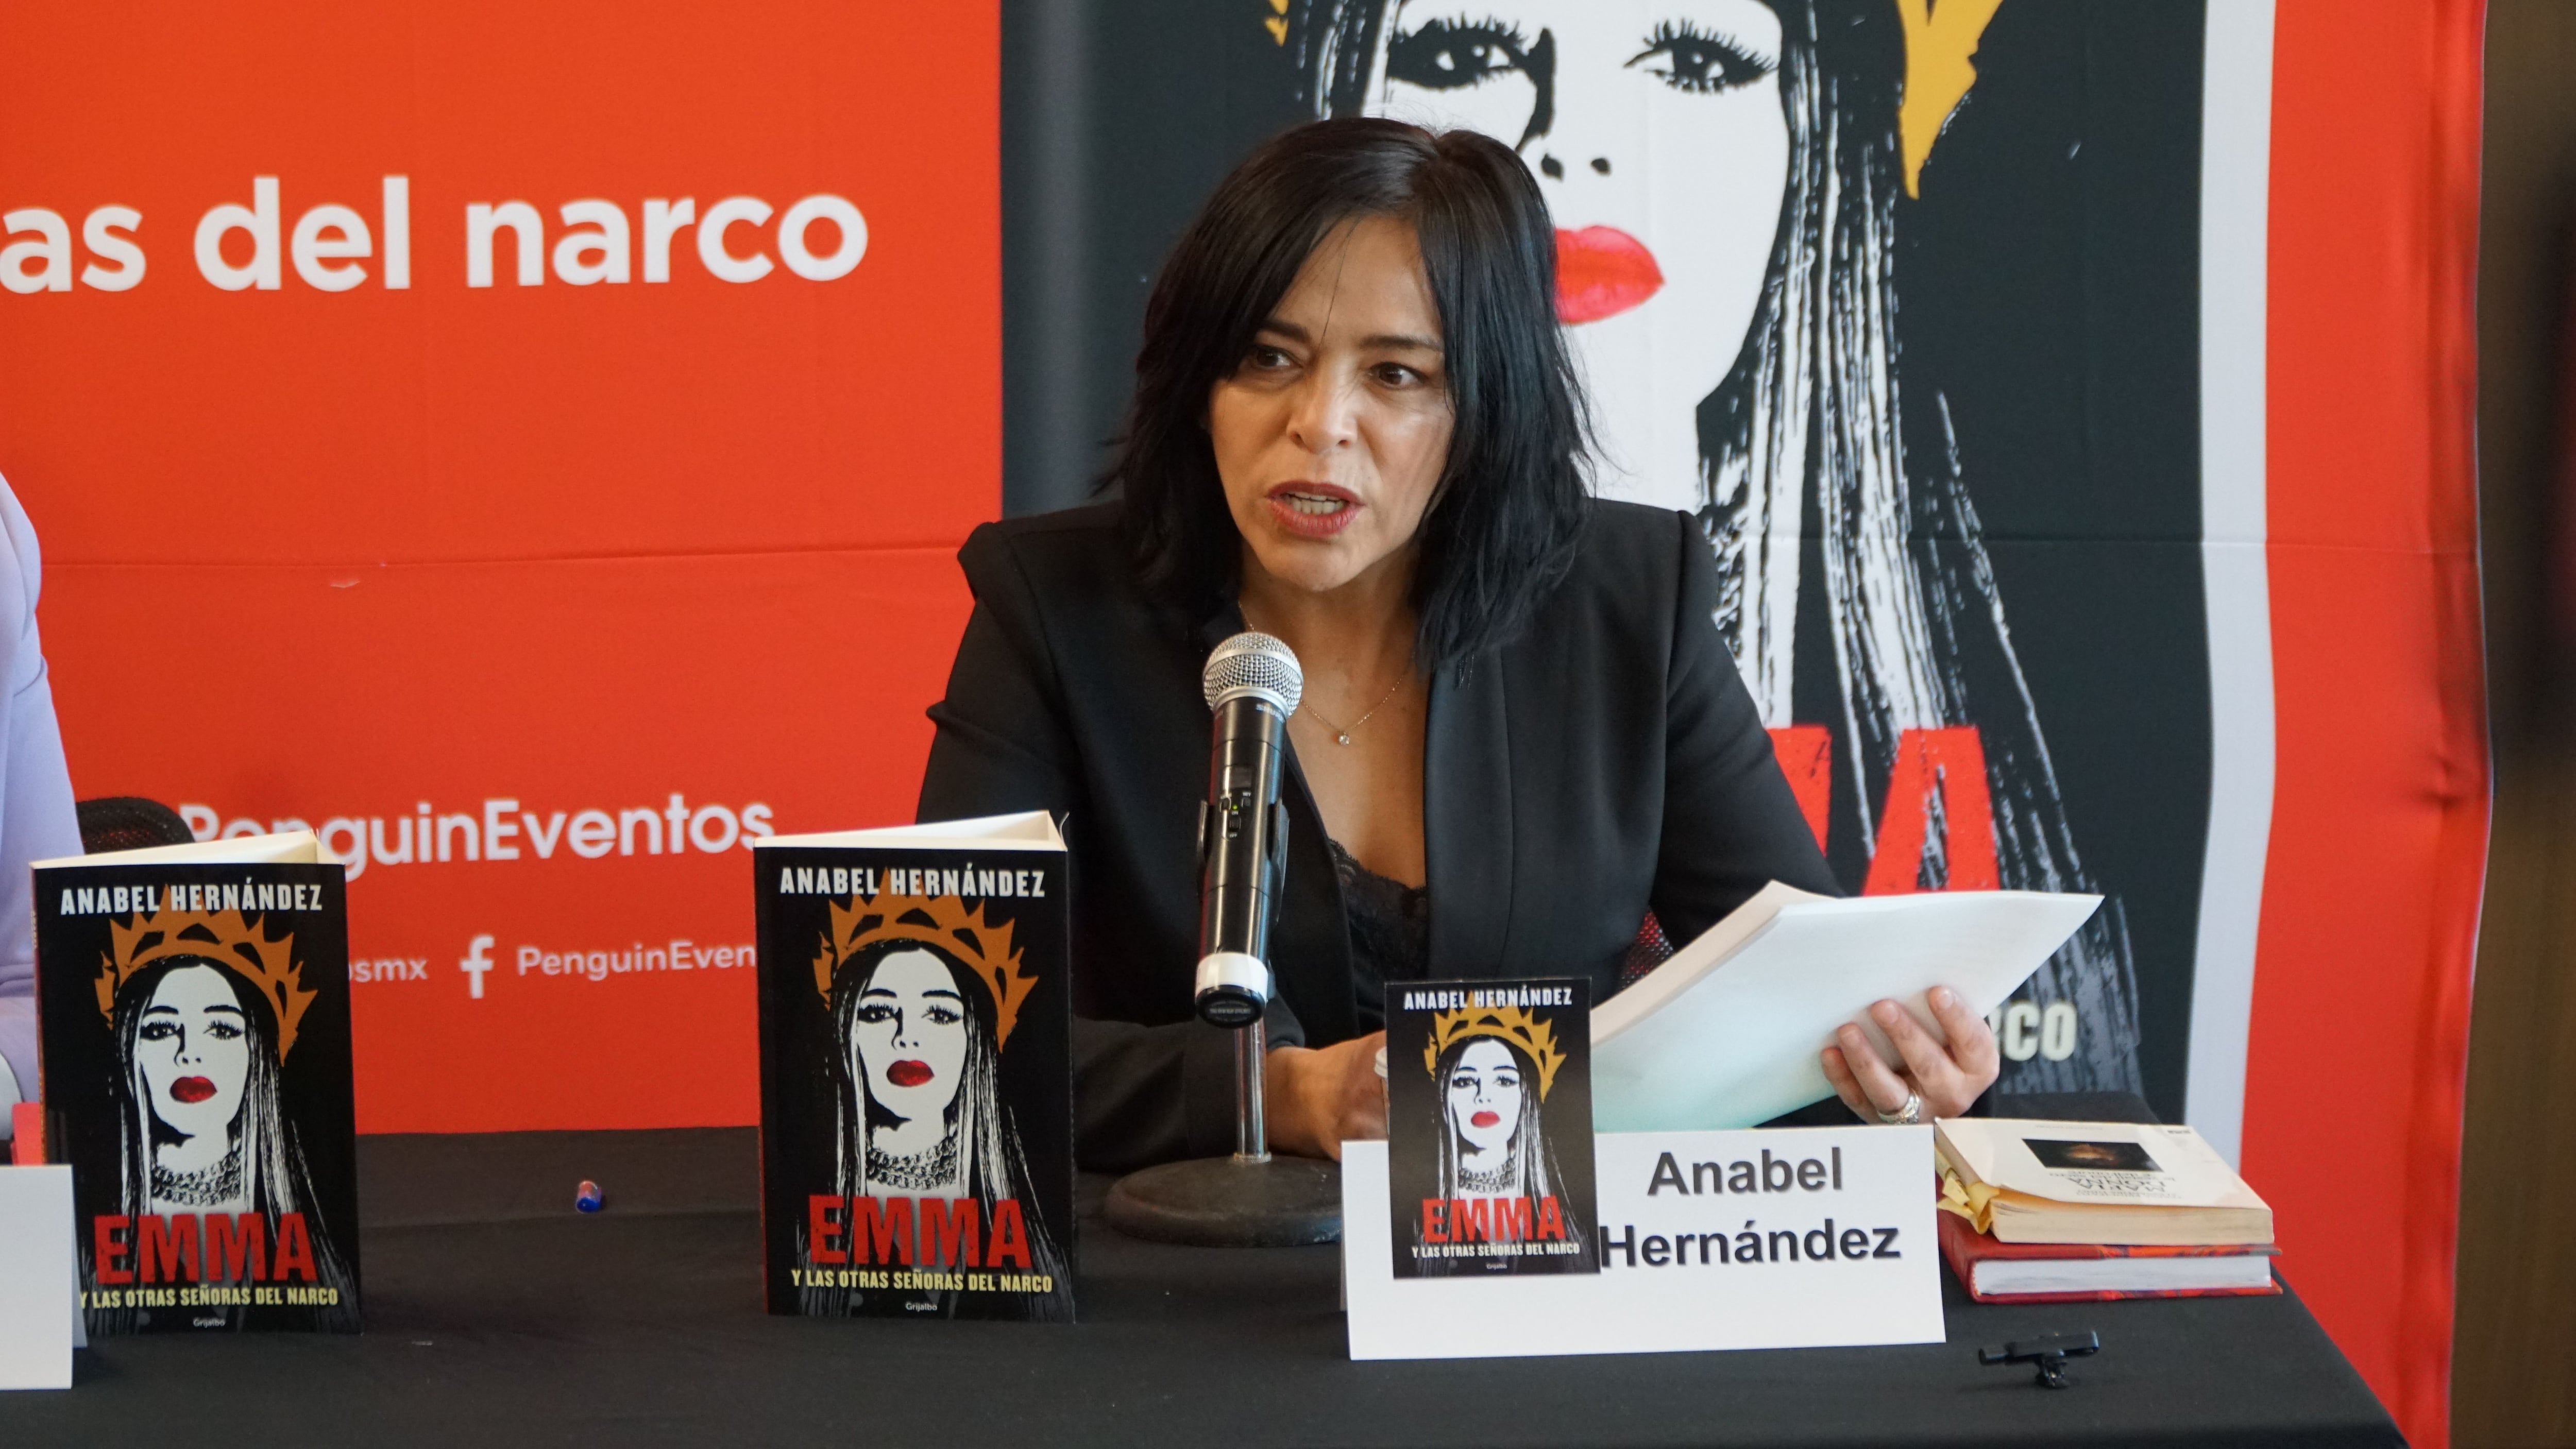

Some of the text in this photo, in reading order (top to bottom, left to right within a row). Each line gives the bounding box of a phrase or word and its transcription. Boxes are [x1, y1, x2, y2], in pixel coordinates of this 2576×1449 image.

[0, 175, 869, 294] as del narco
[1767, 725, 2001, 896] A
[61, 877, 323, 915] ANABEL HERNÁNDEZ
[780, 862, 1045, 898] ANABEL HERNÁNDEZ
[348, 957, 428, 982] smx
[518, 940, 756, 981] PenguinEven
[1403, 985, 1572, 1010] ANABEL HERNÁNDEZ
[1648, 1147, 1842, 1196] Anabel
[808, 1194, 1032, 1268] EMMA
[1422, 1193, 1566, 1242] EMMA
[94, 1212, 318, 1284] EMMA
[1412, 1240, 1580, 1258] Y LAS OTRAS SEÑORAS DEL NARCO
[1599, 1218, 1901, 1268] Hernández
[79, 1284, 338, 1309] Y LAS OTRAS SEÑORAS DEL NARCO
[791, 1268, 1053, 1293] Y LAS OTRAS SEÑORAS DEL NARCO
[905, 1302, 938, 1311] Grijalbo
